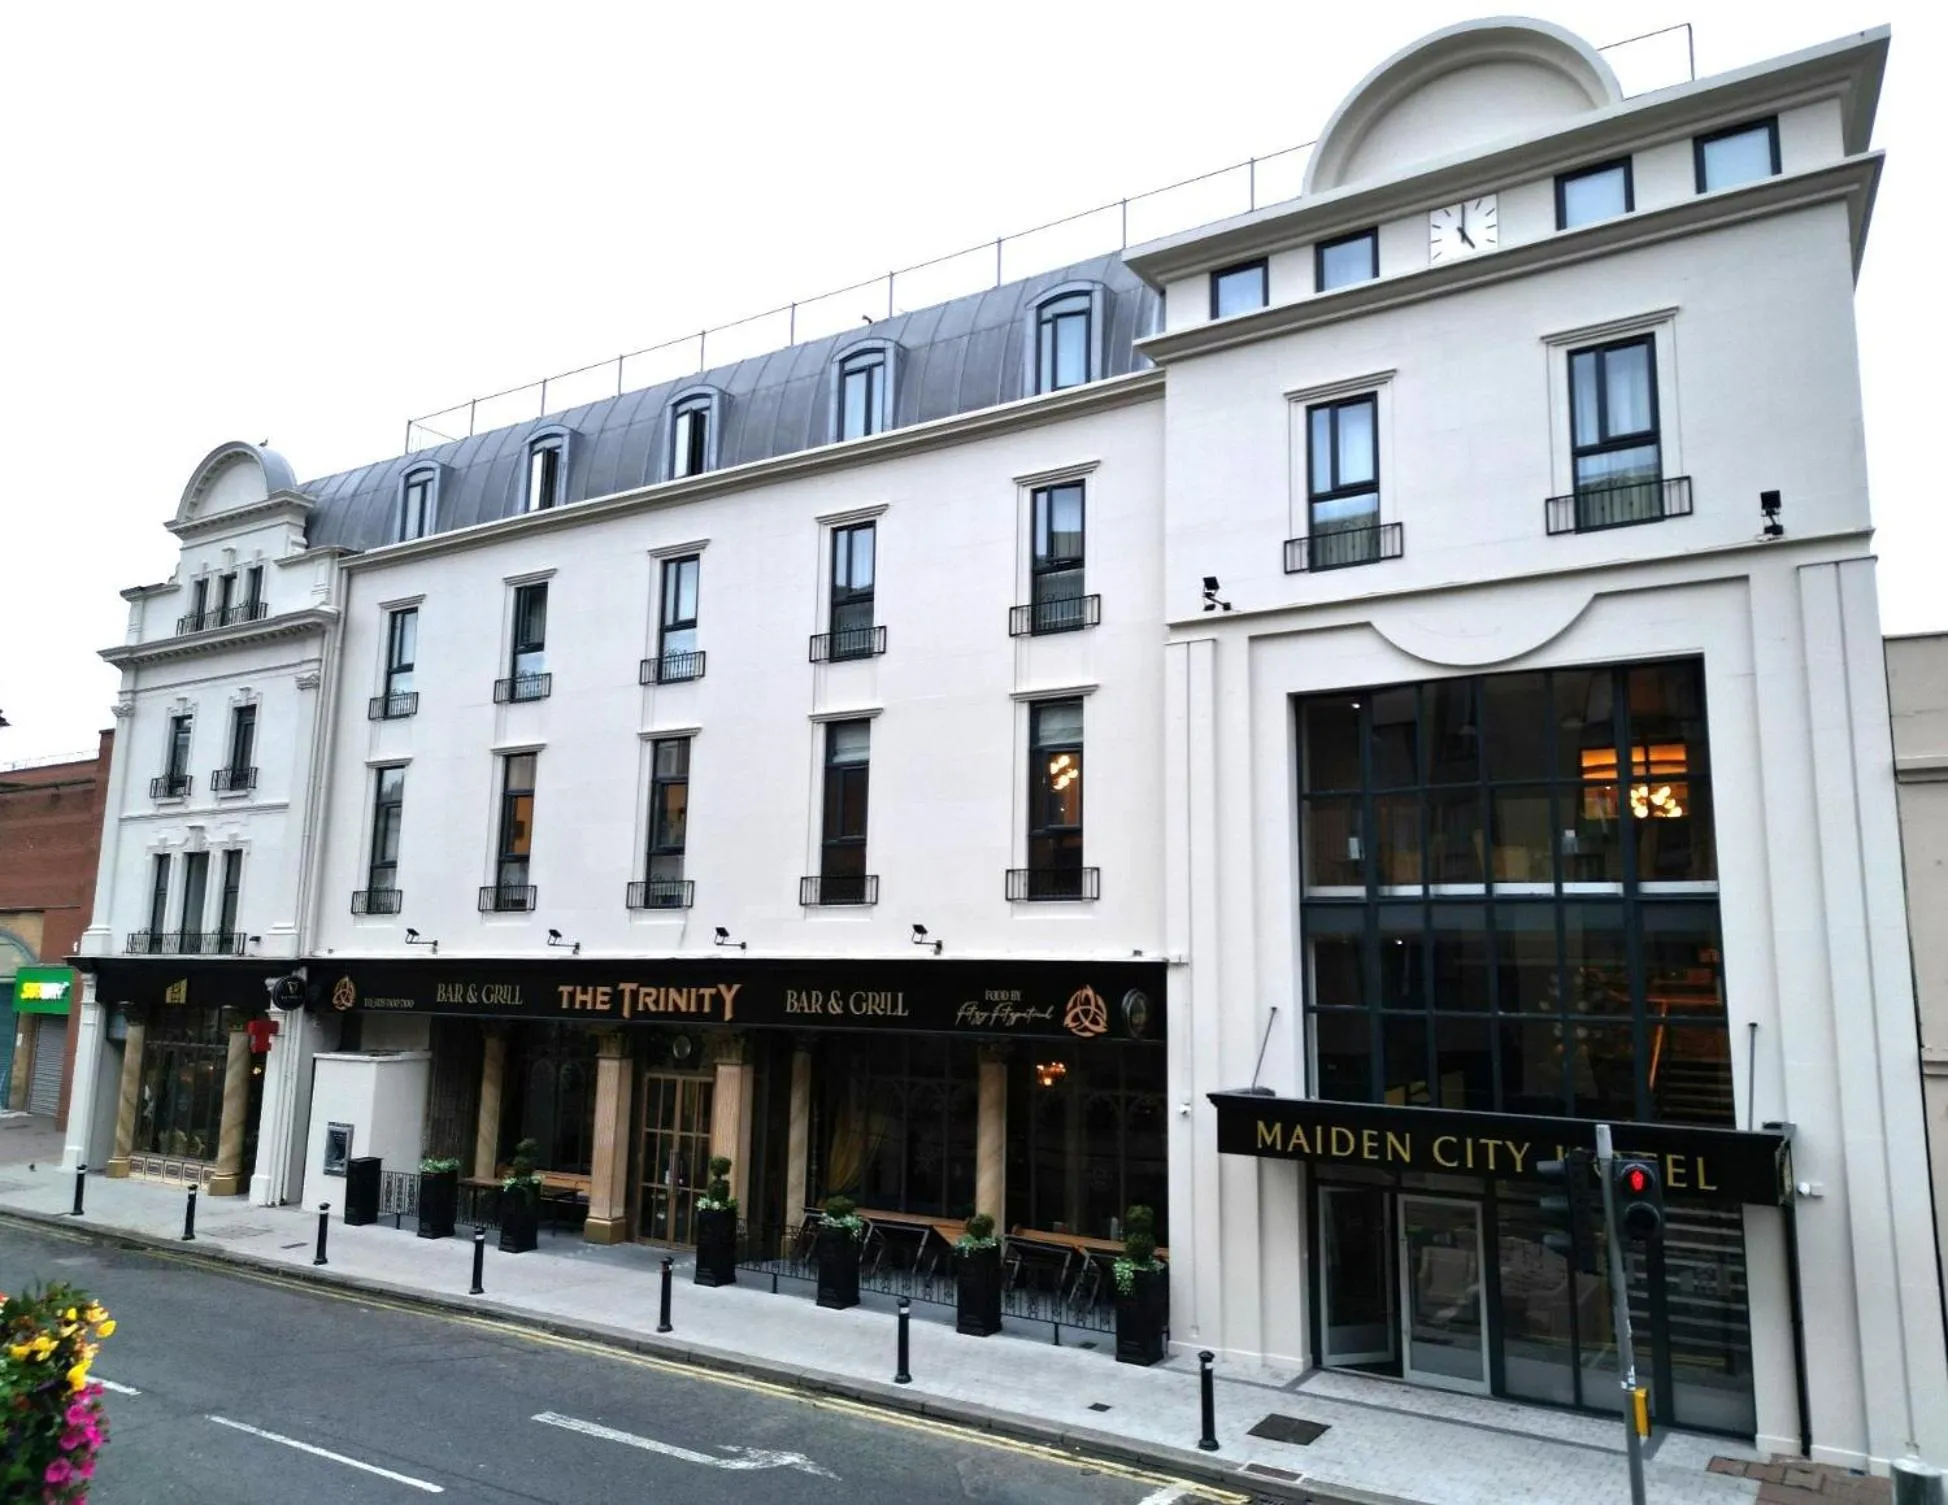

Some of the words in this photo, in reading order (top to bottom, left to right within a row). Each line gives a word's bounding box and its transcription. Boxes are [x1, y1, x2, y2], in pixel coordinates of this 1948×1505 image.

[437, 984, 465, 1003] BAR
[466, 983, 478, 1004] &
[481, 985, 523, 1005] GRILL
[558, 985, 613, 1010] THE
[618, 982, 741, 1021] TRINITY
[785, 990, 823, 1014] BAR
[826, 990, 844, 1015] &
[848, 991, 909, 1016] GRILL
[1256, 1120, 1412, 1163] MAIDEN
[1432, 1136, 1530, 1173] CITY
